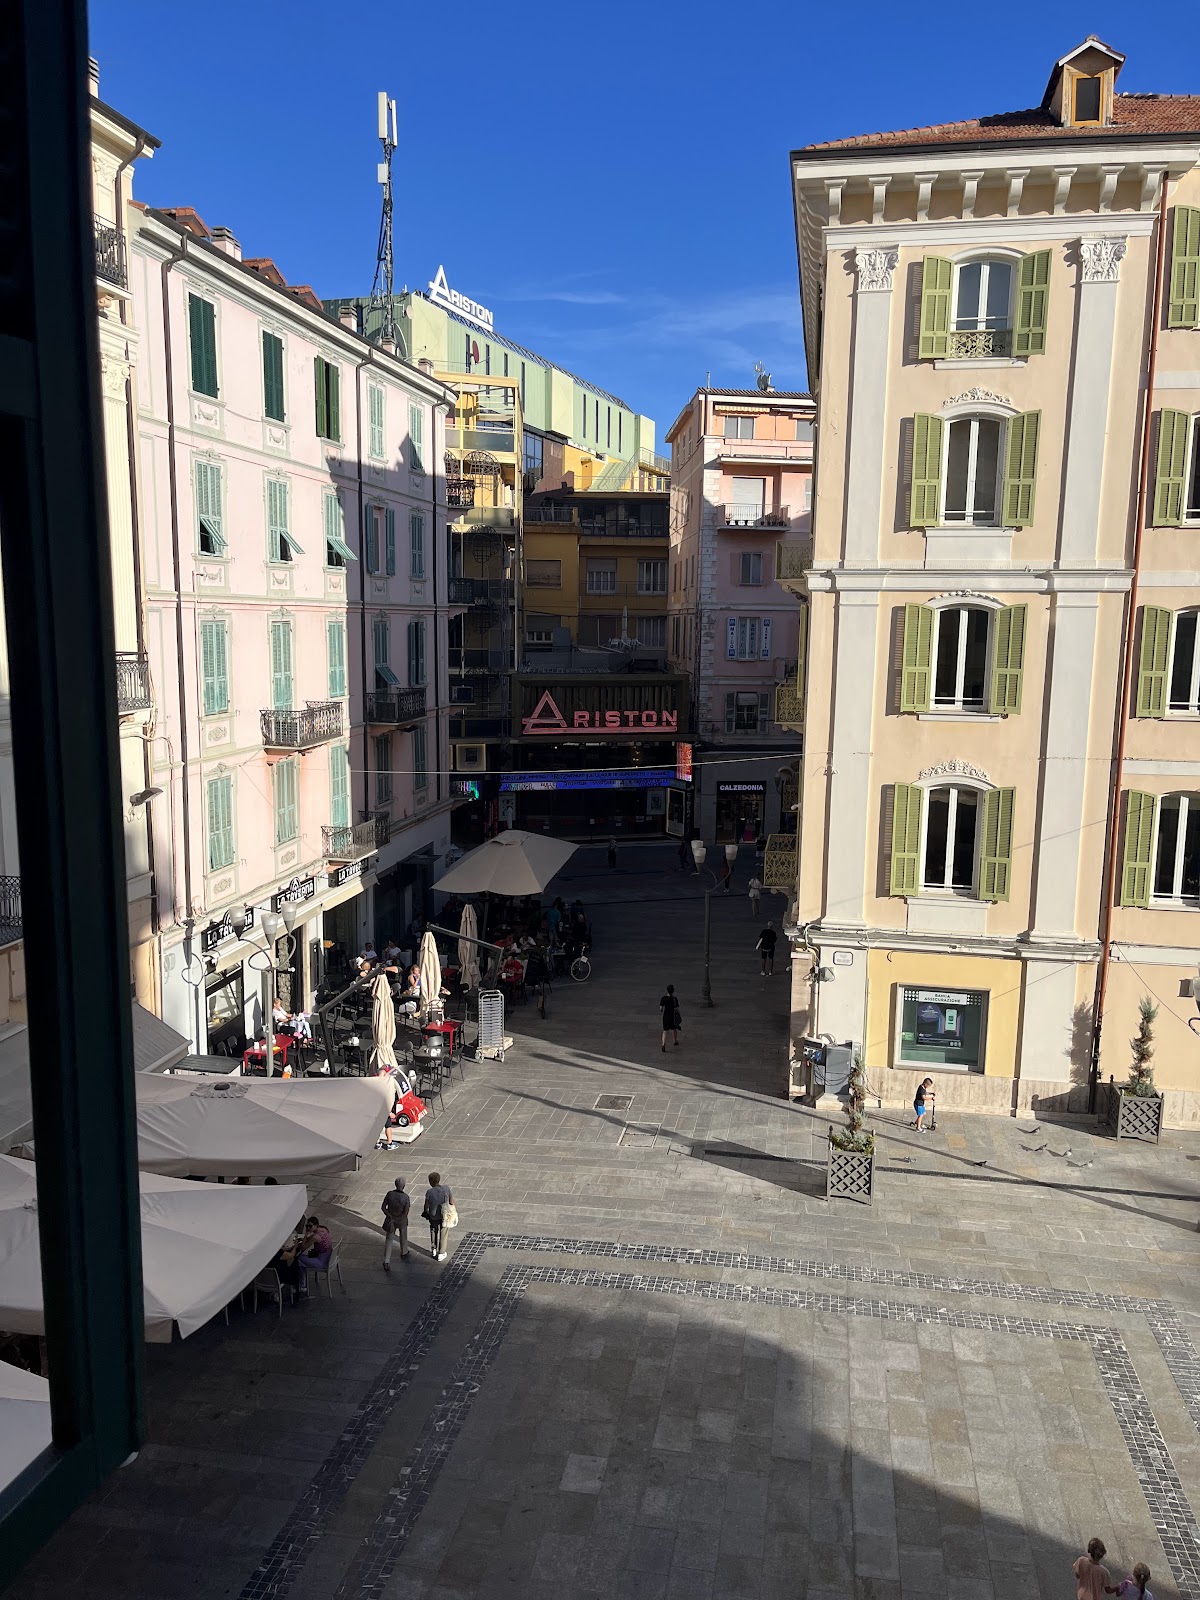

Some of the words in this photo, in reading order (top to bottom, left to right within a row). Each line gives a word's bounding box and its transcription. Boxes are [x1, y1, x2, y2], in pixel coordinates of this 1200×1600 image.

[428, 264, 493, 331] ARISTON
[522, 690, 677, 734] ARISTON
[339, 871, 346, 882] LA
[207, 931, 217, 946] LA
